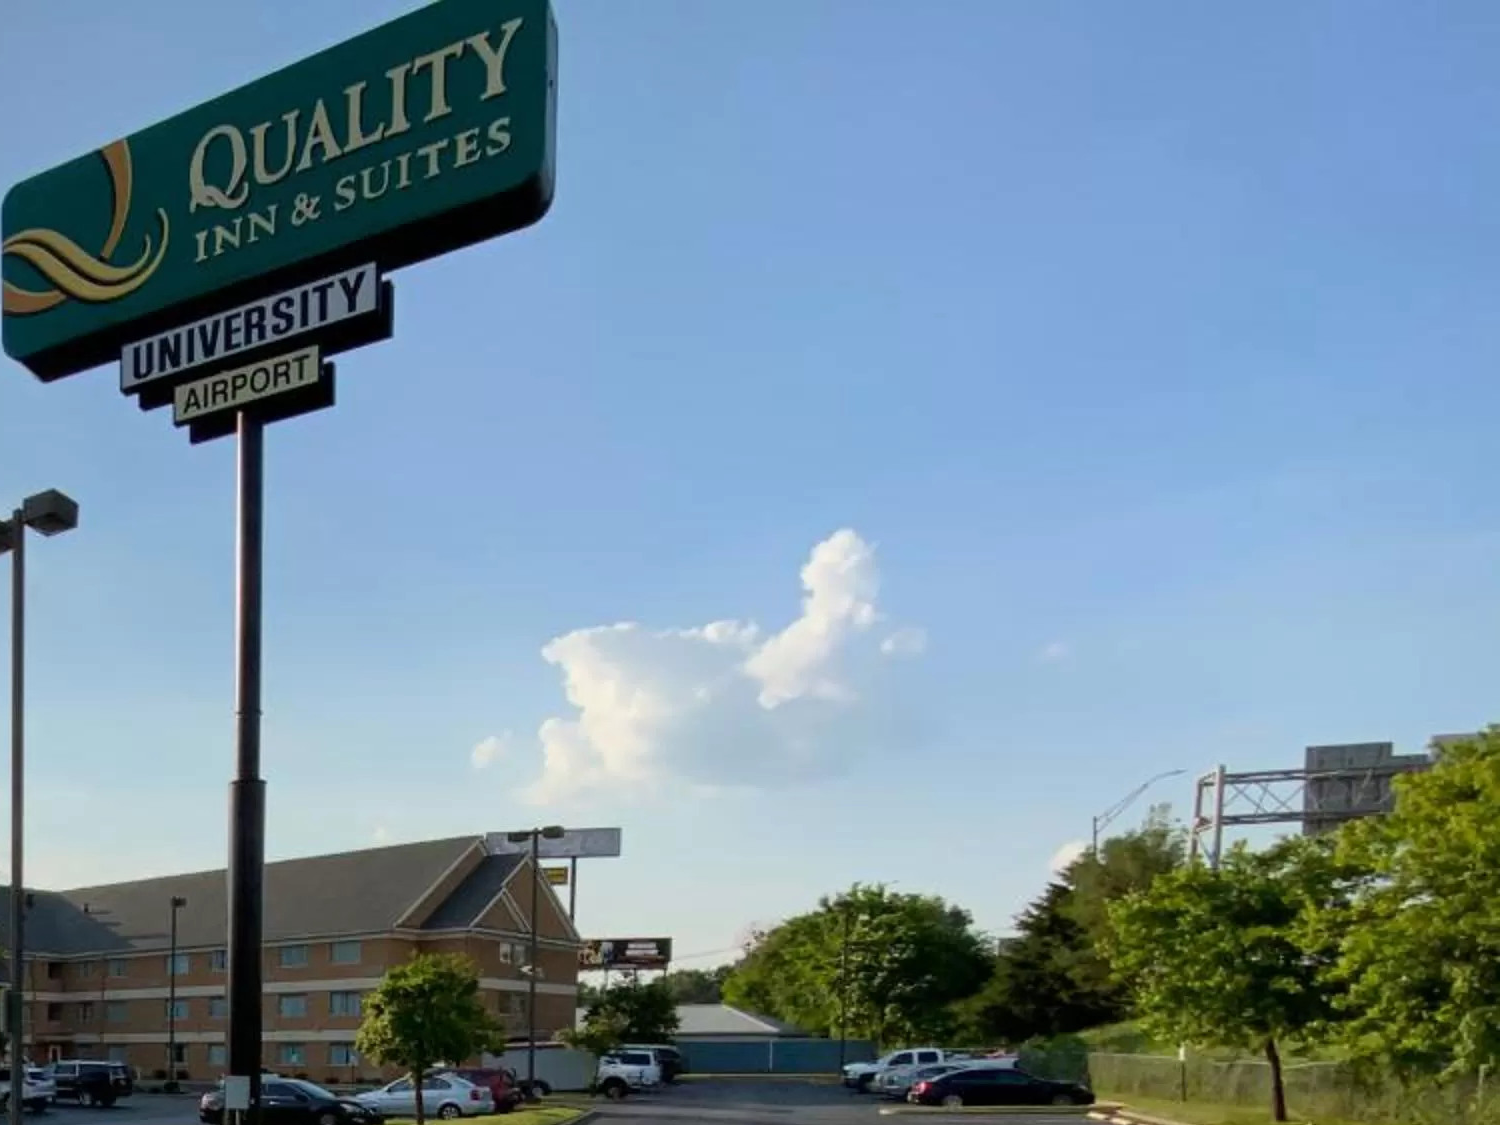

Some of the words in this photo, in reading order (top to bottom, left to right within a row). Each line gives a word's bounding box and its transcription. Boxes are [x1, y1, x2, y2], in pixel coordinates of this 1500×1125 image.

[189, 18, 522, 211] QUALITY
[196, 204, 276, 263] INN
[291, 194, 321, 227] &
[334, 118, 512, 211] SUITES
[132, 271, 367, 380] UNIVERSITY
[183, 354, 311, 413] AIRPORT
